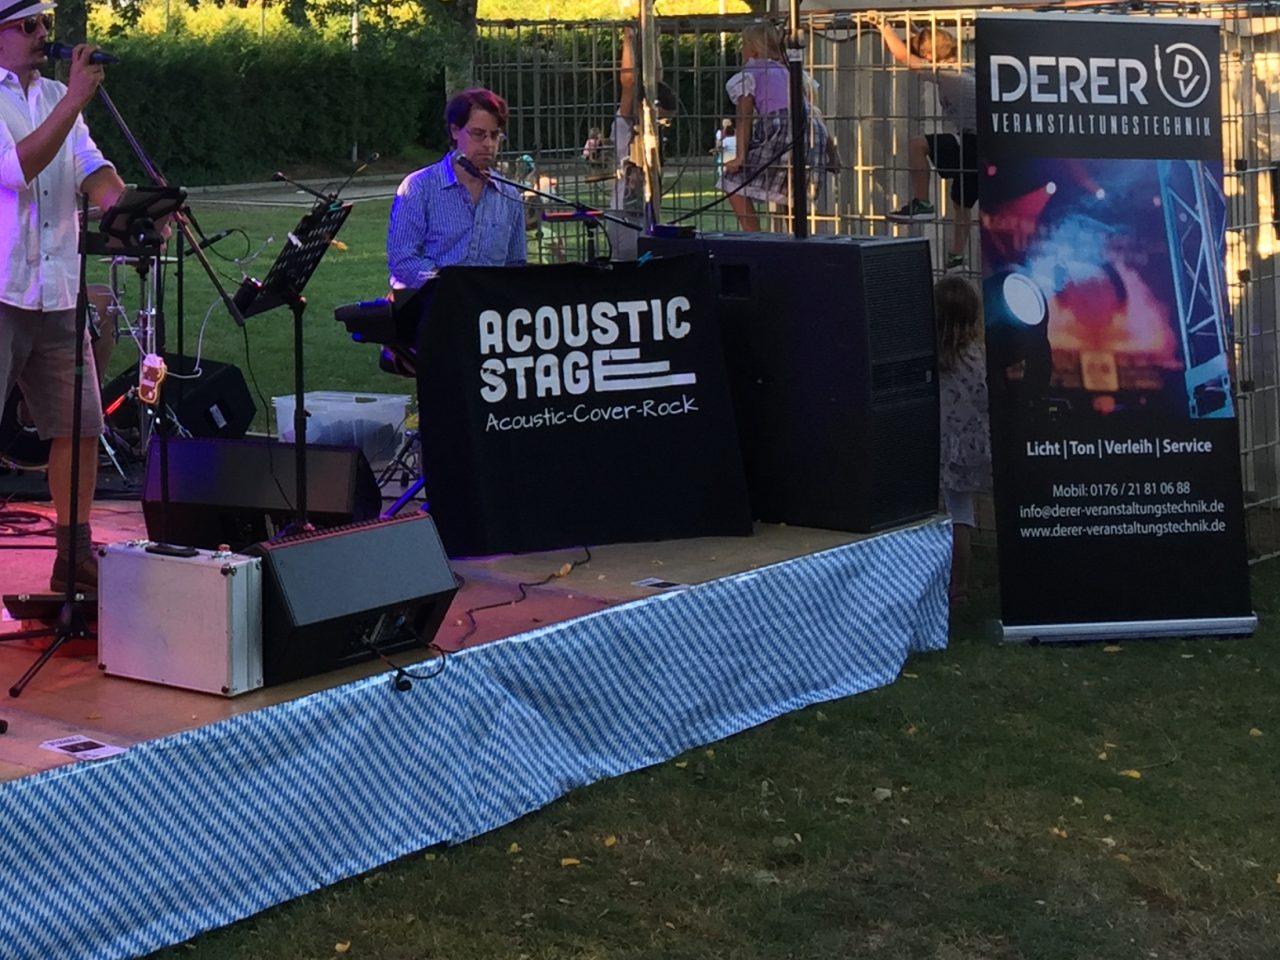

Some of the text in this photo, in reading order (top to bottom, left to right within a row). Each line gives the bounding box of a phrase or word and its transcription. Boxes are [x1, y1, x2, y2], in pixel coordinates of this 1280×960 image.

[990, 55, 1149, 105] DERER
[991, 112, 1211, 137] VERANSTALTUNGSTECHNIK
[478, 295, 692, 355] ACOUSTIC
[479, 347, 697, 403] STAGE
[485, 393, 699, 433] Acoustic-Cover-Rock
[1026, 440, 1061, 457] Licht
[1069, 440, 1095, 456] Ton
[1104, 438, 1153, 455] Verleih
[1162, 438, 1213, 455] Service
[1052, 483, 1089, 498] Mobil:
[1090, 482, 1119, 497] 0176
[1128, 482, 1141, 496] 21
[1143, 481, 1157, 495] 81
[1159, 481, 1174, 495] 06
[1176, 480, 1191, 495] 88
[1019, 499, 1225, 520] info@derer-veranstaltungstechnik.de
[1020, 518, 1227, 538] www.derer-veranstaltungstechnik.de
